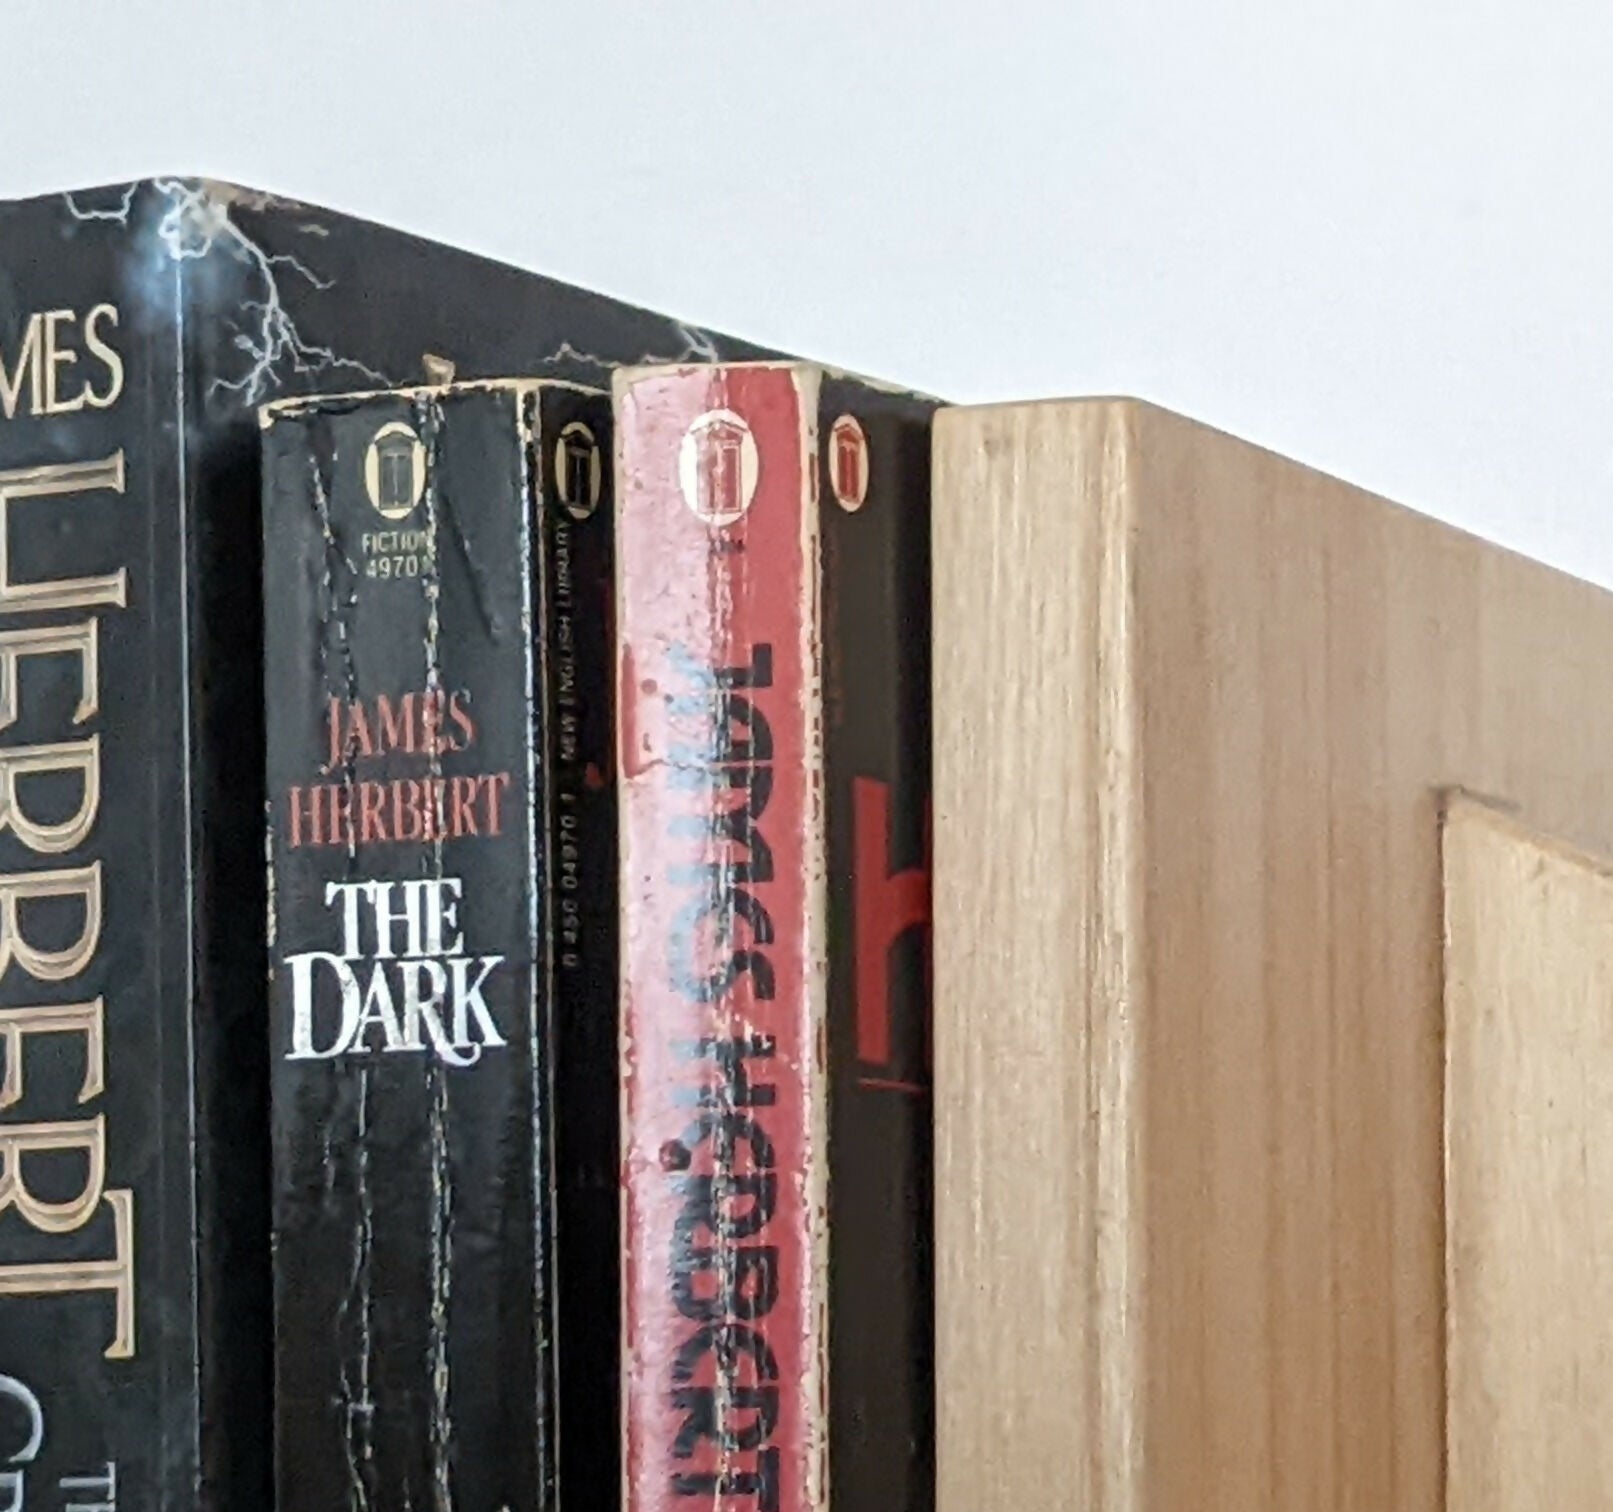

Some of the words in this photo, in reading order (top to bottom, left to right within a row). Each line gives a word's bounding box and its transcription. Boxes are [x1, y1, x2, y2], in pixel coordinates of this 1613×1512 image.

[320, 687, 477, 775] JAMES
[559, 711, 576, 760] NEW
[290, 771, 510, 848] HERBERT
[665, 642, 774, 1004] JAMES
[325, 876, 465, 960] THE
[284, 951, 508, 1066] DARK
